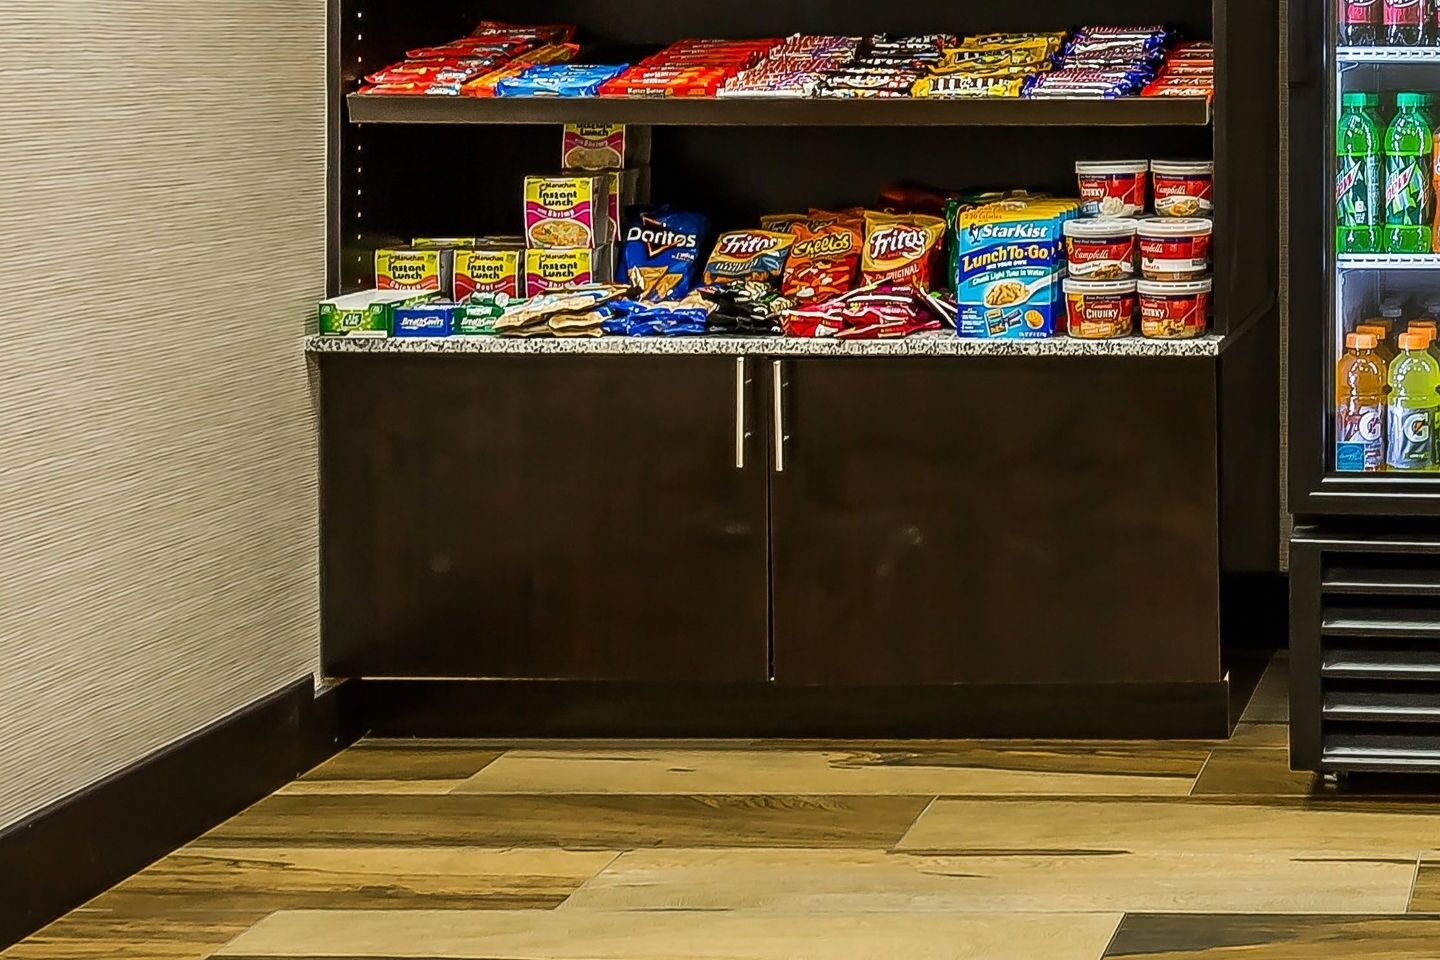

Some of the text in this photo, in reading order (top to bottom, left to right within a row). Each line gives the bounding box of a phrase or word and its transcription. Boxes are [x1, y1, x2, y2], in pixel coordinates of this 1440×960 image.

[538, 190, 577, 200] Instant
[543, 198, 574, 207] Lunch
[548, 209, 575, 218] Shrimp
[982, 223, 1049, 239] StarKist
[627, 227, 696, 248] Doritos
[720, 234, 779, 254] Fritos
[870, 228, 926, 259] Fritos
[962, 246, 1007, 272] Lunch
[388, 263, 426, 272] Instant
[467, 263, 504, 272] Instant
[538, 261, 578, 271] Instant
[393, 271, 422, 280] Lunch
[471, 271, 500, 280] Lunch
[543, 269, 574, 278] Lunch
[1086, 308, 1119, 319] CHUNKY
[1359, 410, 1381, 441] G
[1403, 413, 1430, 443] G
